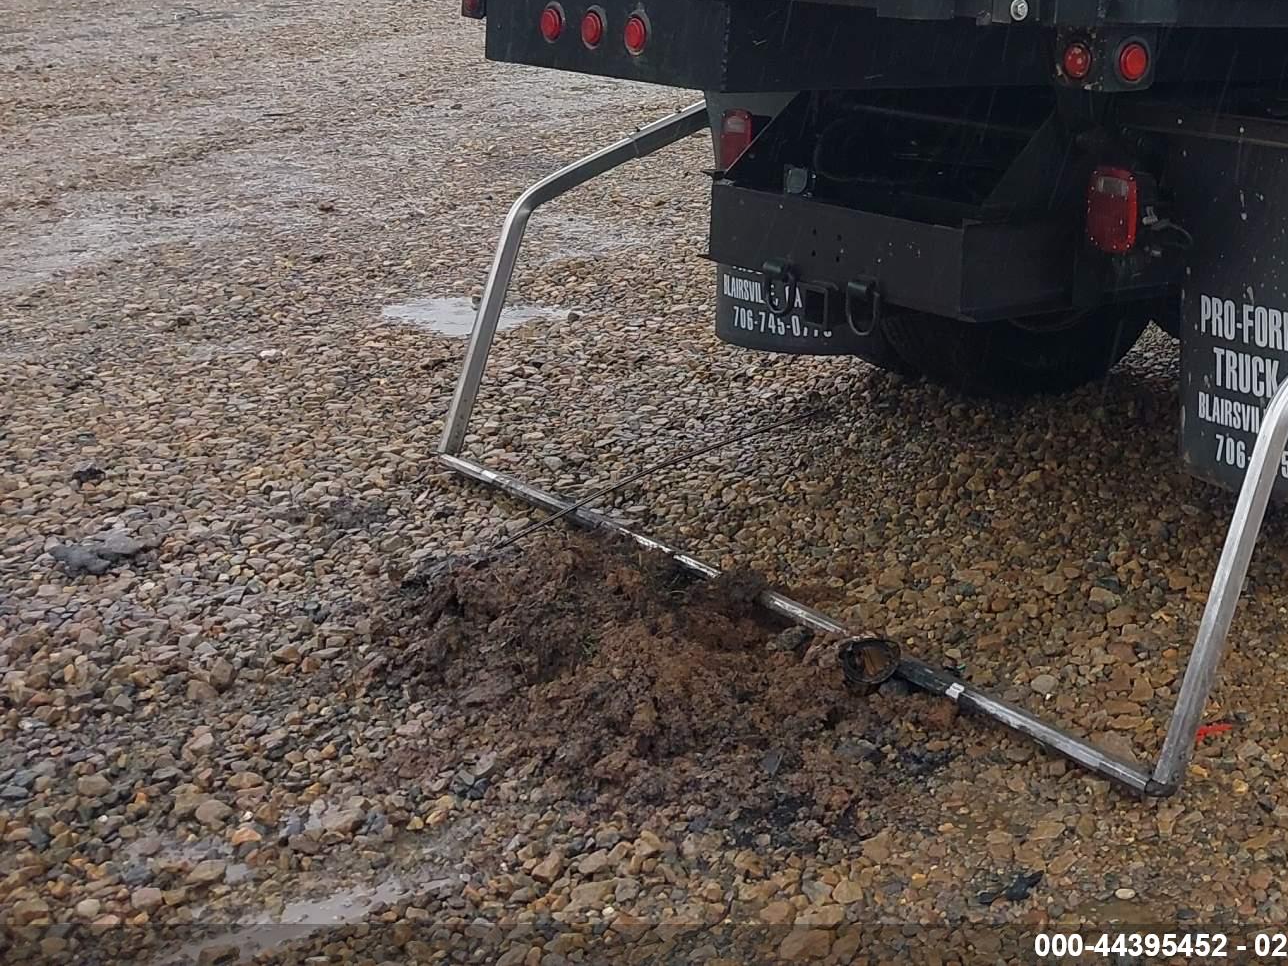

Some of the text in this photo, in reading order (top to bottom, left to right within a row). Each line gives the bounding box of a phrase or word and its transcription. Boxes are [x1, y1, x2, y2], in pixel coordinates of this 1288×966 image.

[733, 305, 832, 338] 706-745-0
[1213, 346, 1280, 399] TRUCK
[1198, 391, 1268, 434] BLAIRSVIL
